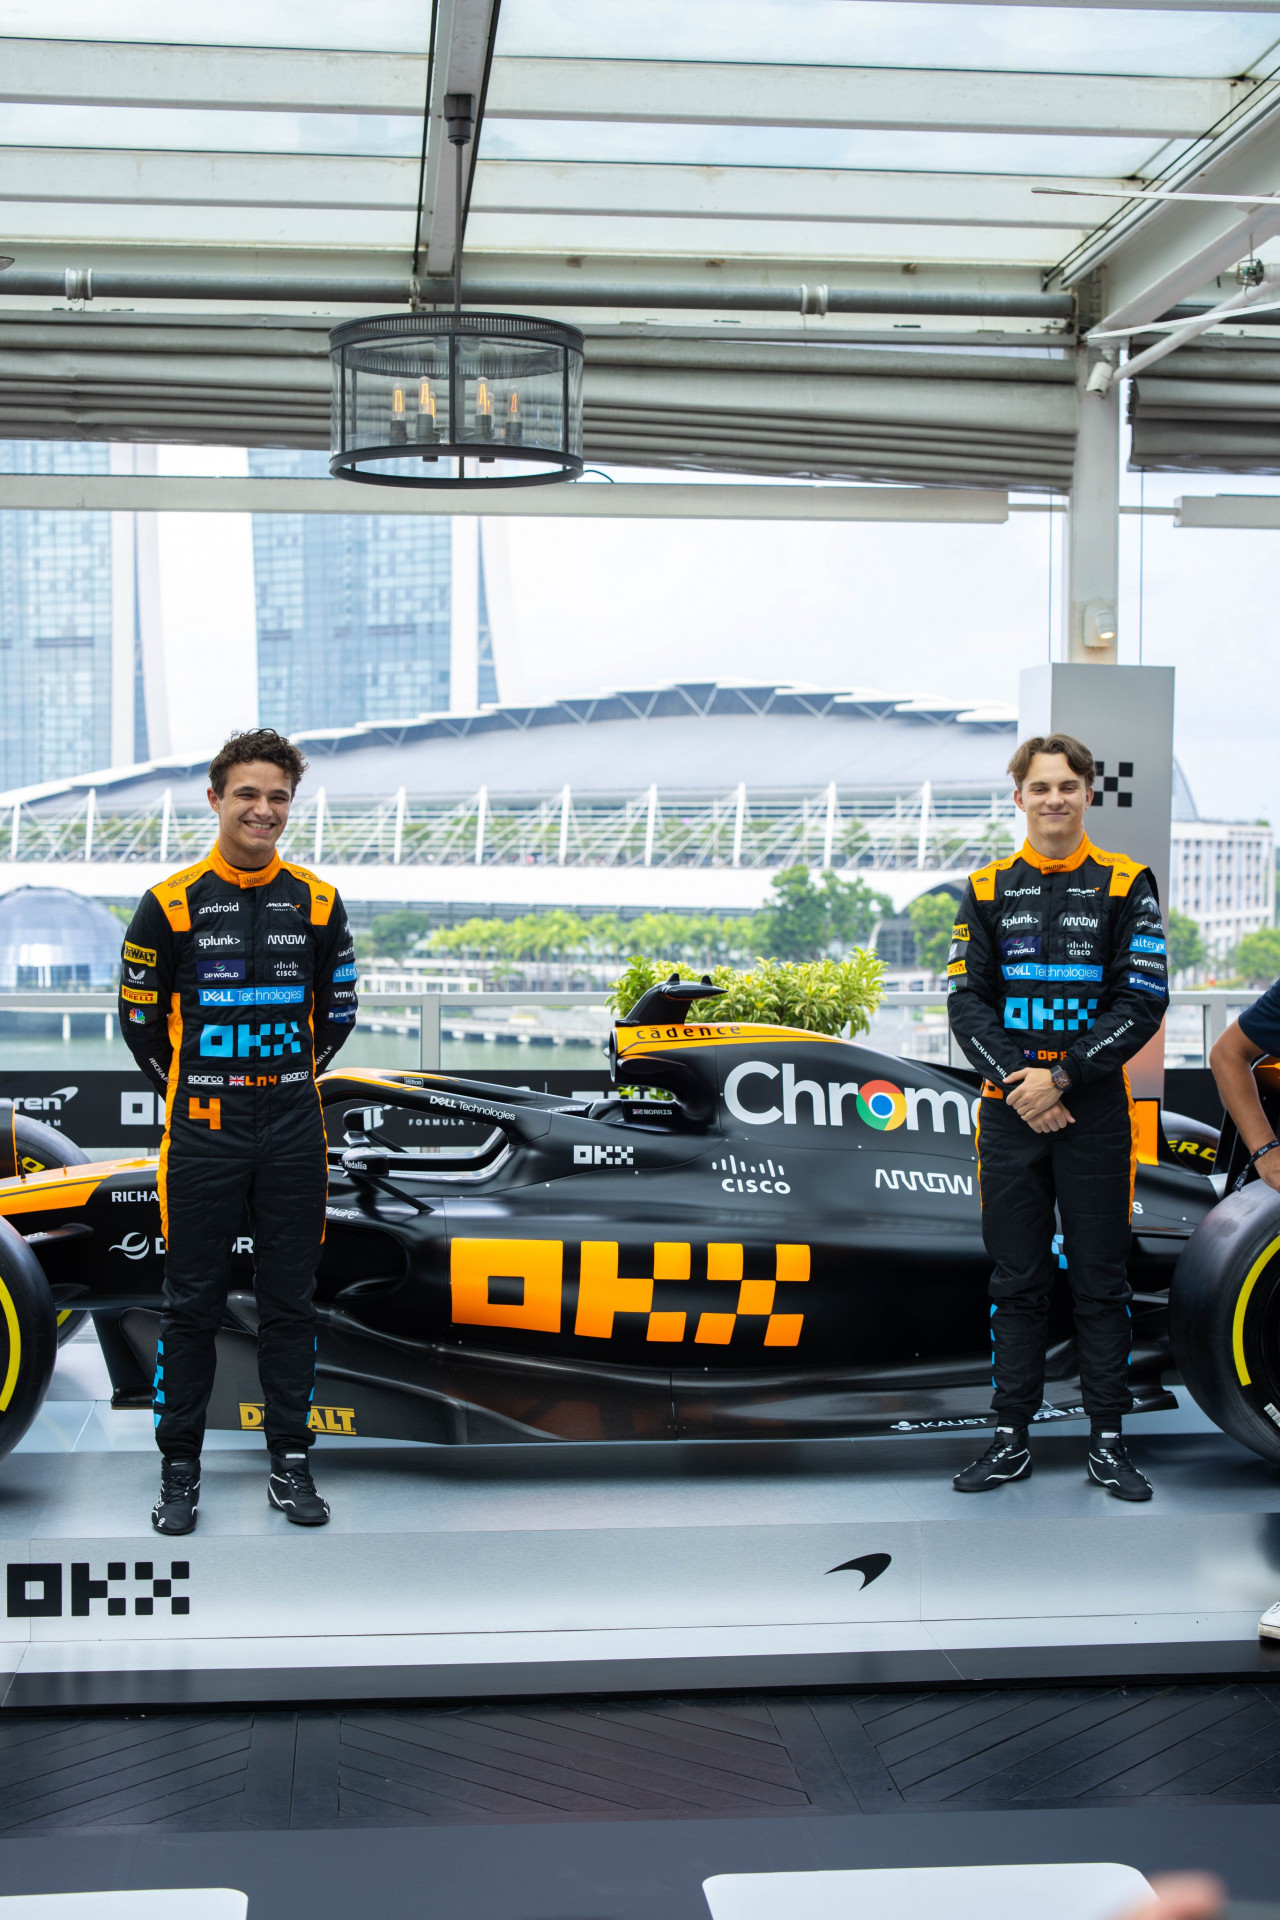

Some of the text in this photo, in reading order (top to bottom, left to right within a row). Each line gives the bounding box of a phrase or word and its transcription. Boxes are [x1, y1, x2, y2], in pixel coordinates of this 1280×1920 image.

[1004, 886, 1041, 897] android
[198, 902, 239, 914] android
[1132, 937, 1165, 953] alteryx
[1006, 965, 1098, 979] DELL Technologies
[1132, 958, 1165, 971] vmware
[202, 988, 302, 1003] DELL Technologies
[1003, 996, 1098, 1030] OKX
[1113, 1019, 1135, 1038] MILLE
[200, 1021, 302, 1057] OKX
[970, 1036, 1008, 1079] RICHARD MIL
[187, 1074, 224, 1085] sparco
[281, 1071, 309, 1083] sparco
[405, 1078, 422, 1086] Hilton
[724, 1061, 981, 1135] Chrom
[188, 1097, 221, 1130] 4
[430, 1095, 516, 1121] DELL Technologies
[574, 1145, 634, 1165] OKX
[344, 1158, 368, 1170] Medallia
[721, 1178, 791, 1195] CISCO
[450, 1237, 811, 1347] OKX
[240, 1405, 354, 1432] DALT
[920, 1417, 987, 1428] KAUST
[6, 1561, 190, 1618] OKX
